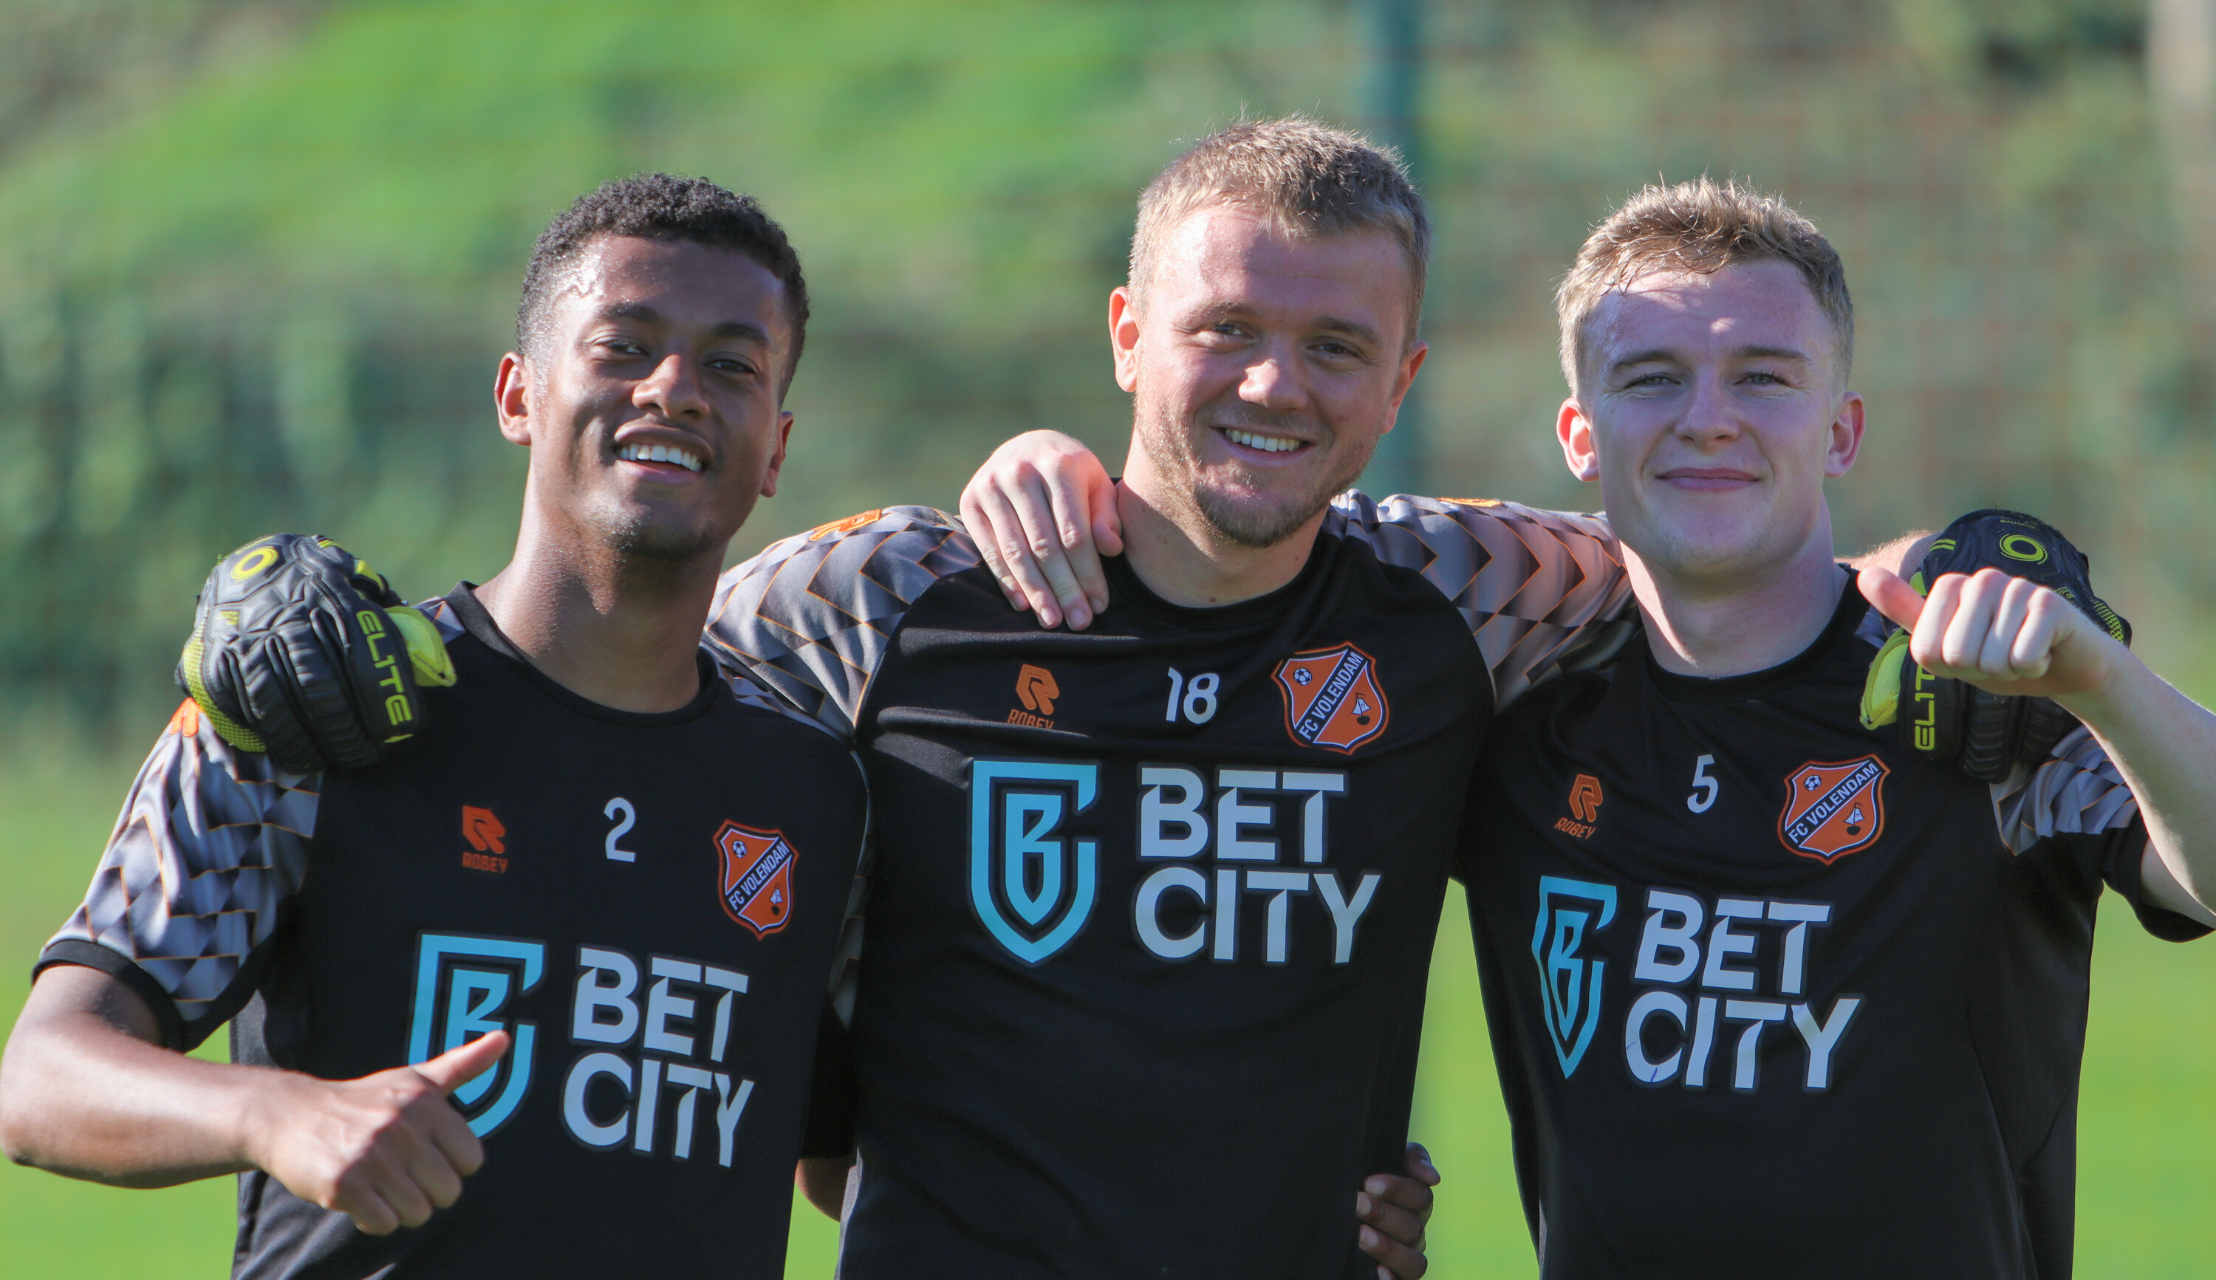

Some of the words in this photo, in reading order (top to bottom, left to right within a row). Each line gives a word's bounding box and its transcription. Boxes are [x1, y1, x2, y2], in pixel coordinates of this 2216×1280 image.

[356, 610, 414, 727] ELITE
[1166, 667, 1220, 725] 18
[1298, 718, 1319, 741] FC
[1311, 651, 1364, 721] VOLENDAM
[1914, 665, 1935, 750] ELIT
[1140, 766, 1345, 864] BET
[1687, 754, 1719, 814] 5
[1787, 822, 1809, 845] FC
[1805, 762, 1879, 826] VOLENDAM
[462, 851, 509, 874] ROBEY
[603, 796, 637, 863] 2
[1553, 817, 1597, 840] ROBEY
[728, 890, 746, 911] FC
[740, 840, 791, 897] VOLENDAM
[1134, 866, 1382, 965] CITY
[1634, 889, 1831, 995] BET
[572, 947, 749, 1063] BET
[1625, 990, 1862, 1091] CITY
[563, 1051, 755, 1168] CITY
